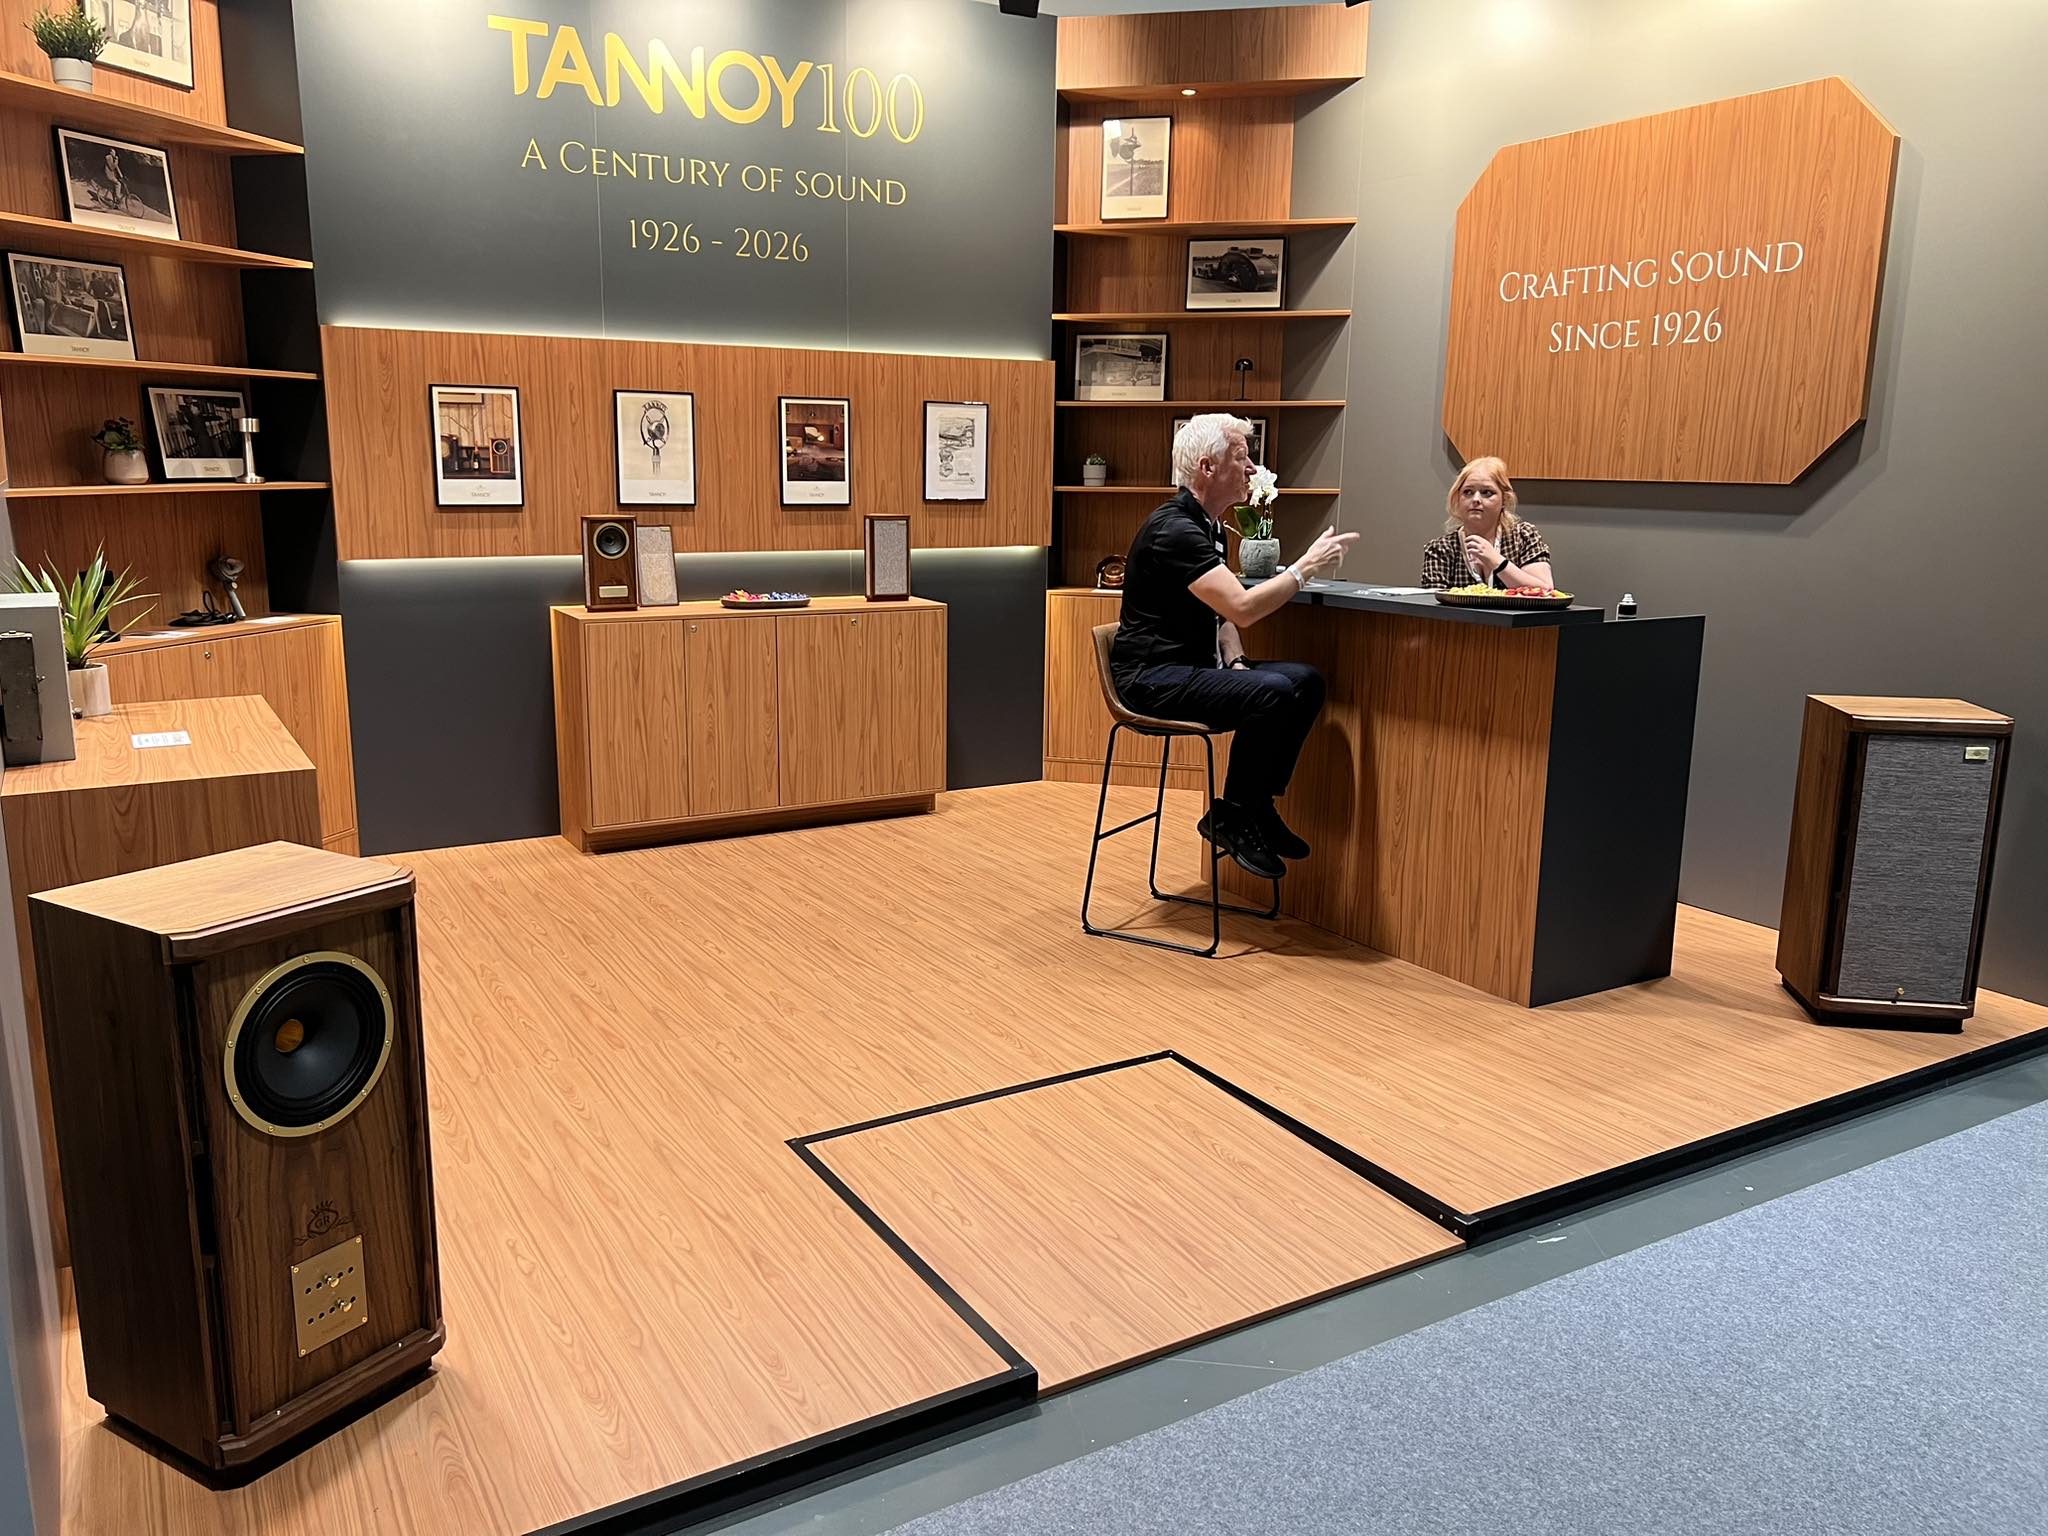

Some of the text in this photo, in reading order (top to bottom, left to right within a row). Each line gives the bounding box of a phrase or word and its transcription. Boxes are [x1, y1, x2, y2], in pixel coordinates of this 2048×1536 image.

[520, 138, 908, 206] A CENTURY OF SOUND
[628, 218, 701, 254] 1926
[734, 227, 810, 263] 2026
[1499, 241, 1804, 303] CRAFTING SOUND
[1548, 306, 1723, 353] SINCE 1926
